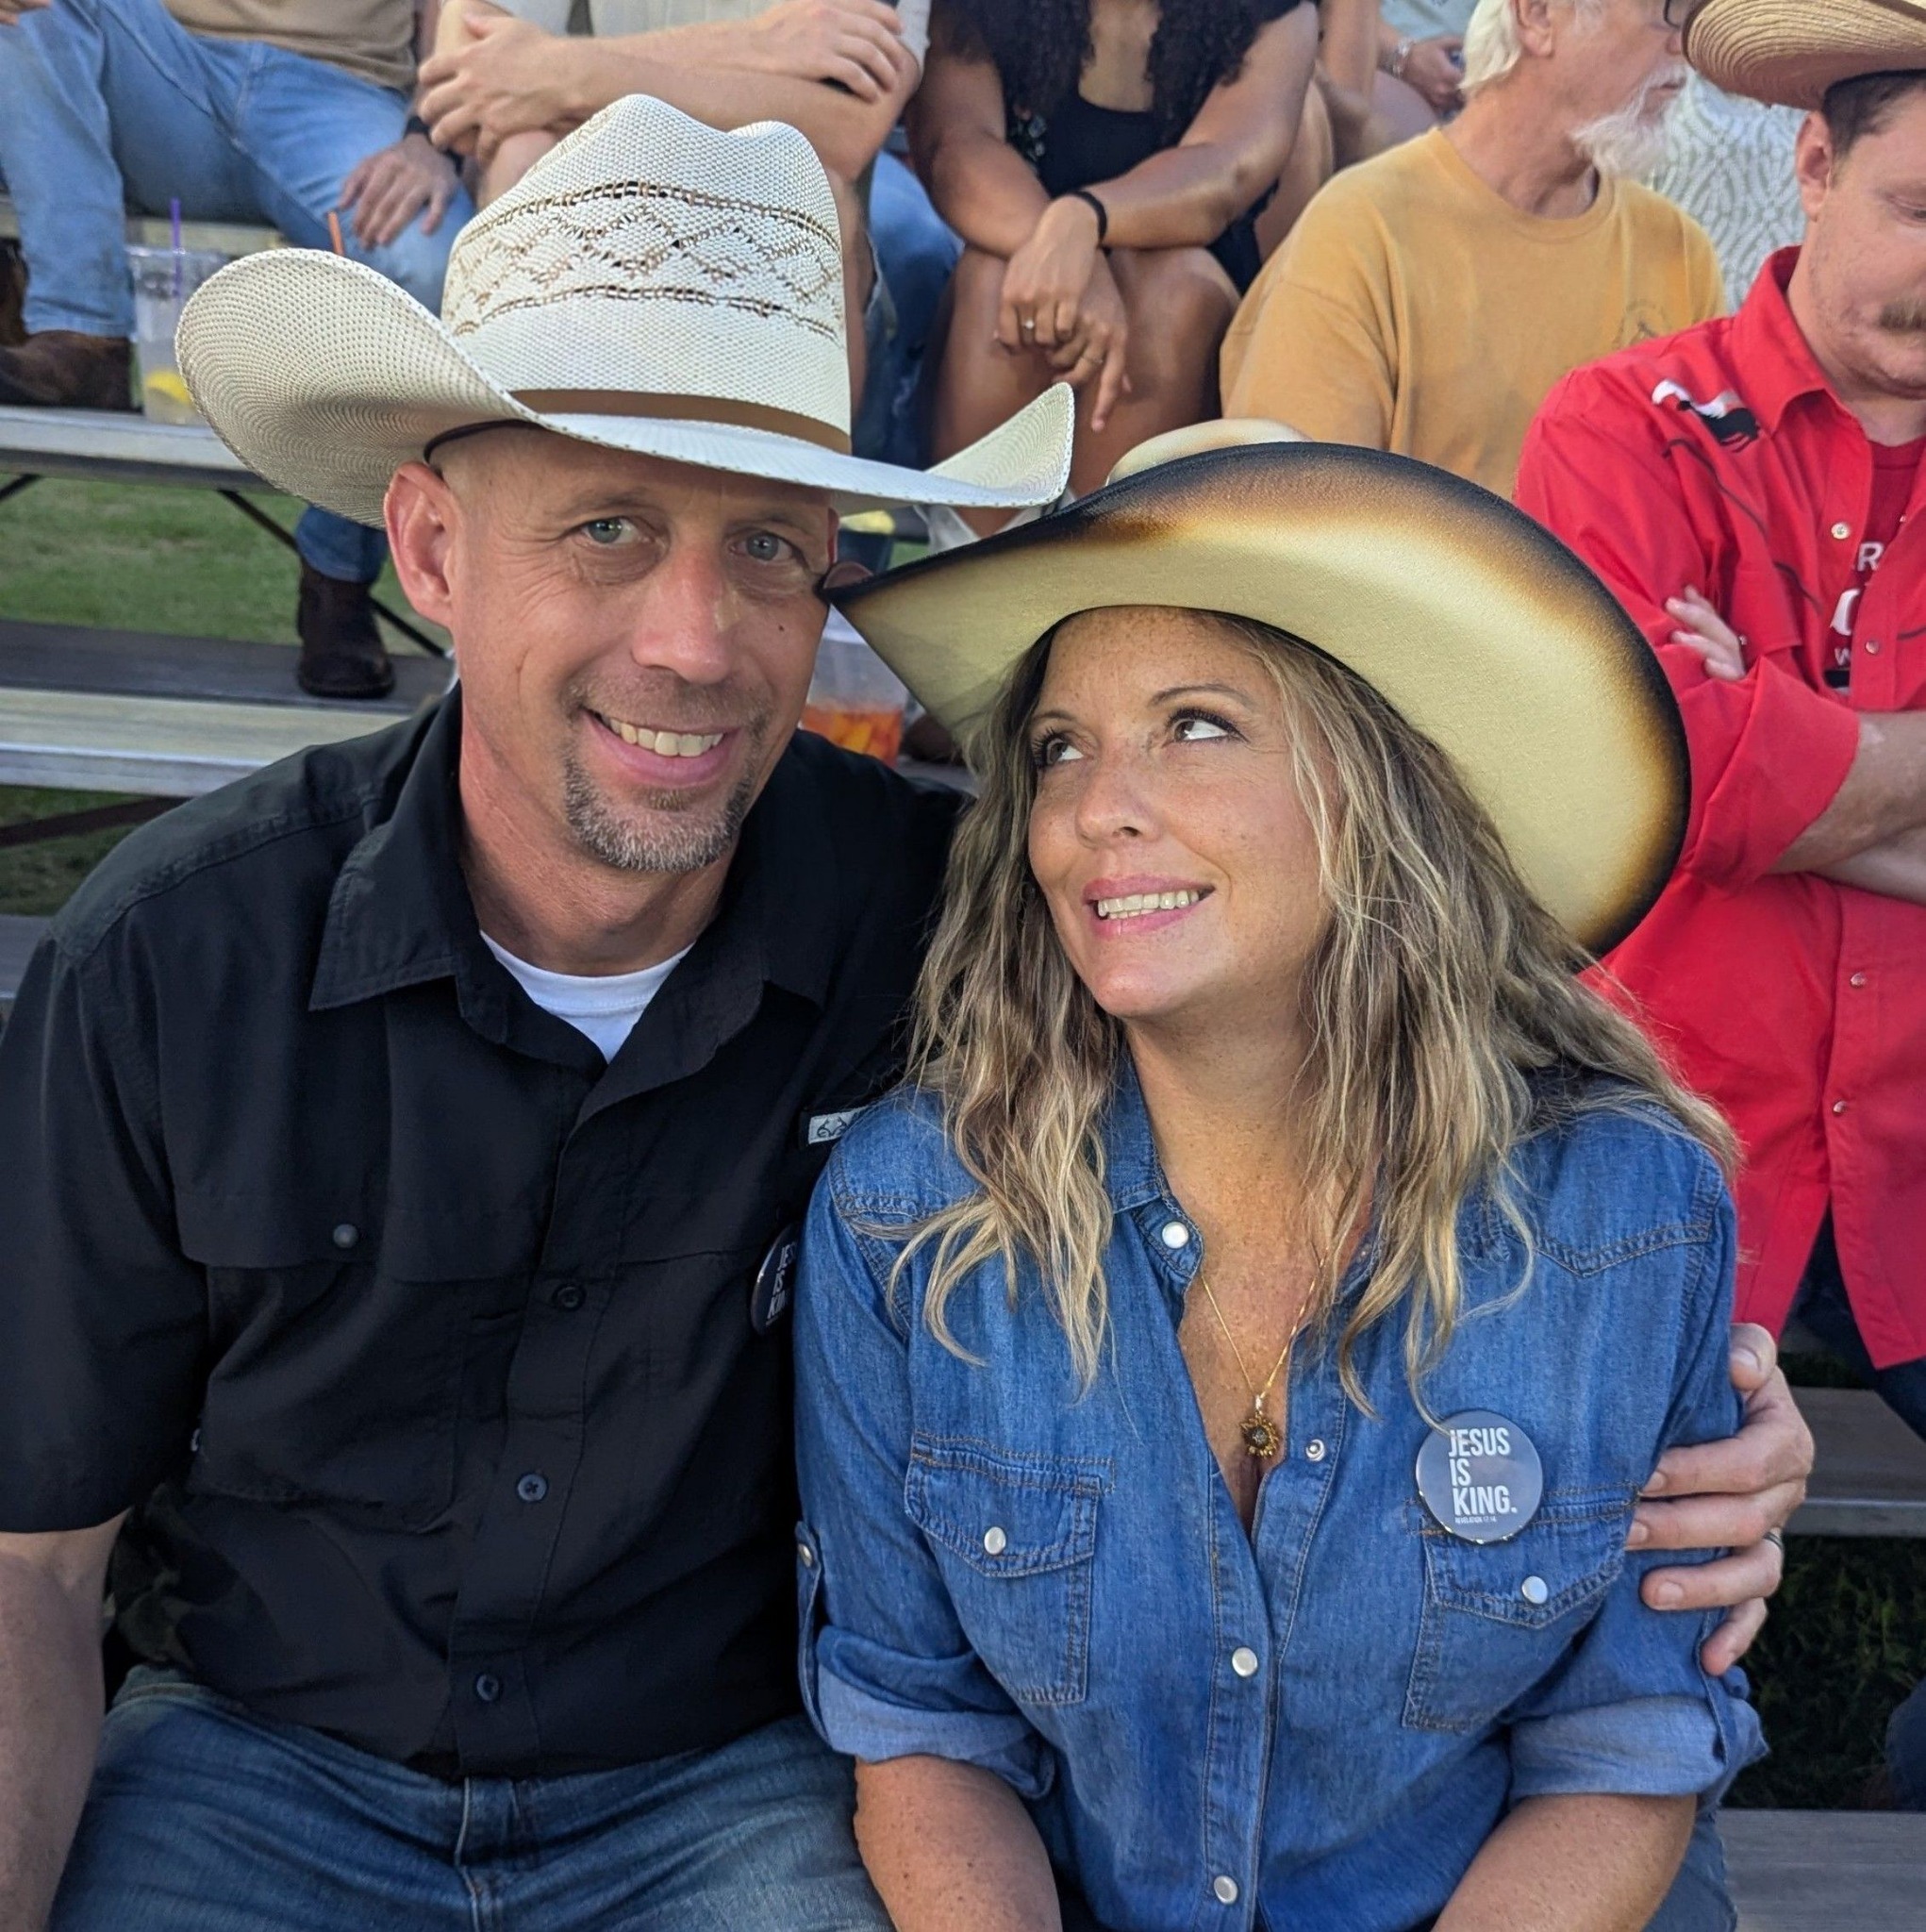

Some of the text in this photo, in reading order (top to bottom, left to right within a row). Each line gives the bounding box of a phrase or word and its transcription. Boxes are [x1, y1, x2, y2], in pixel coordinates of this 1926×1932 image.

[1449, 1427, 1510, 1457] JESUS
[1450, 1458, 1471, 1487] IS
[1453, 1485, 1517, 1515] KING.
